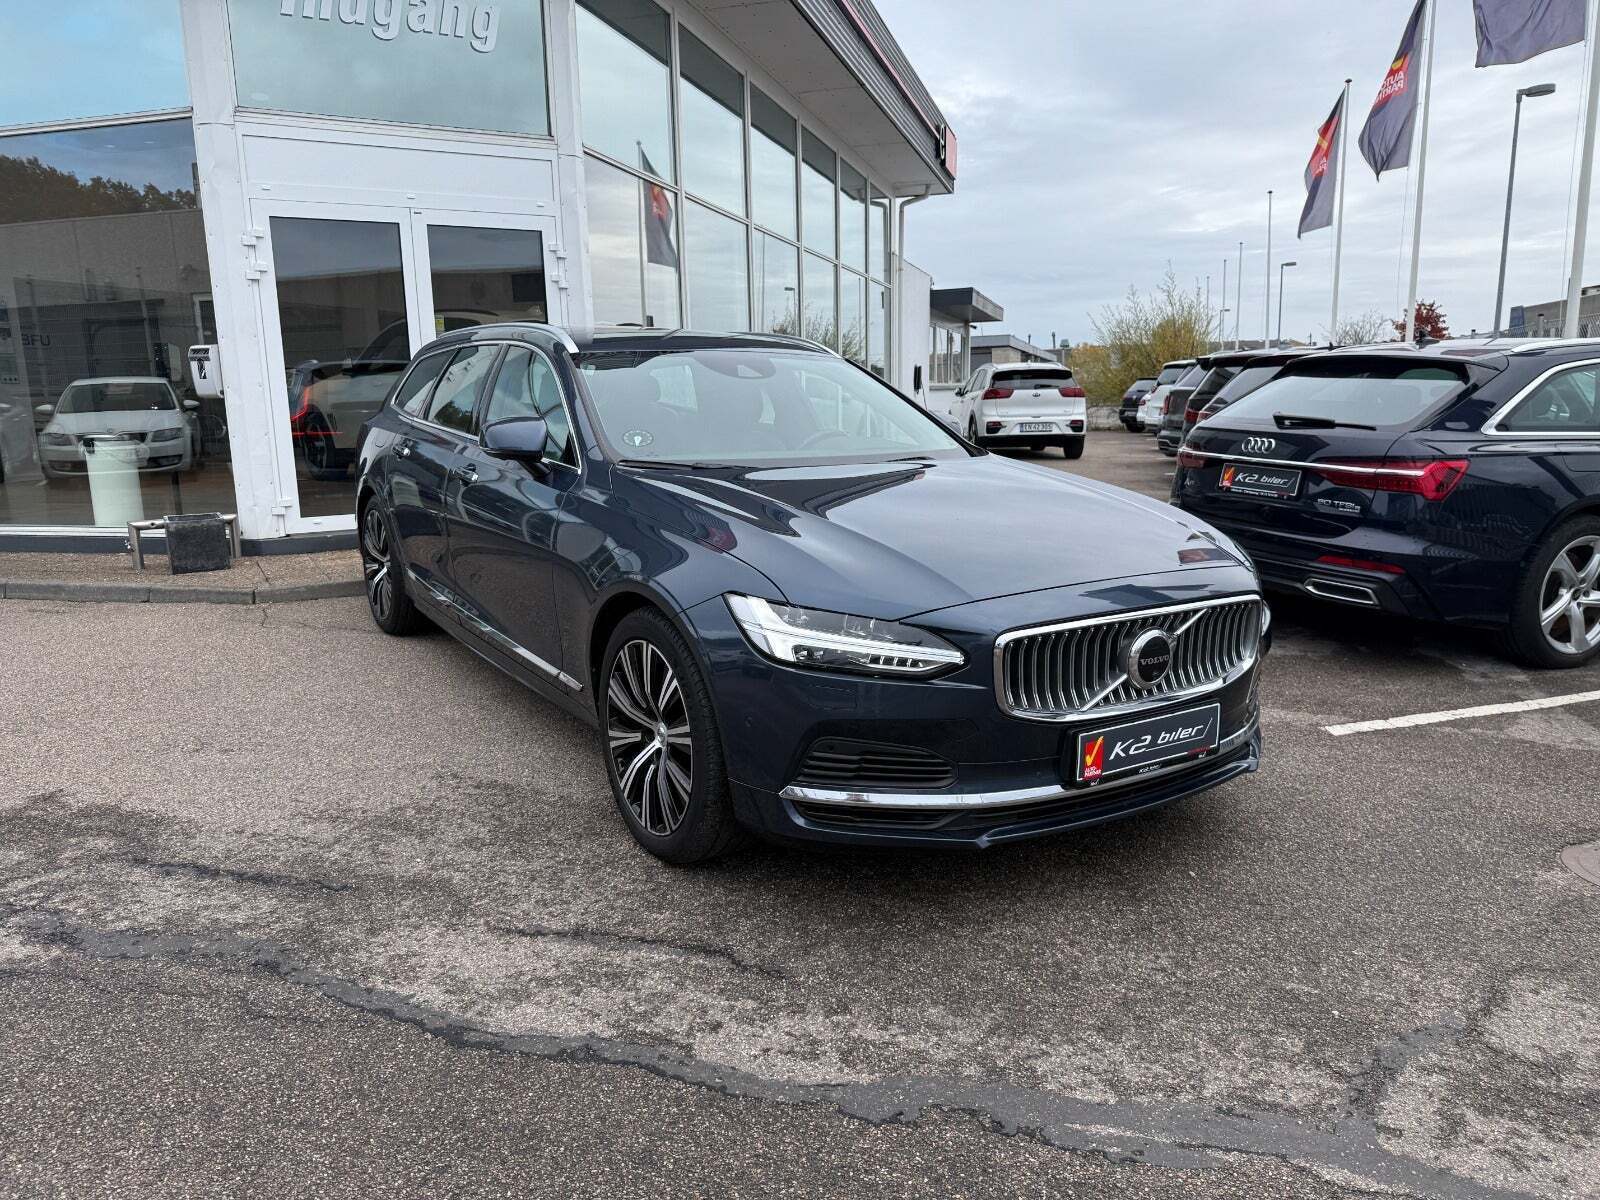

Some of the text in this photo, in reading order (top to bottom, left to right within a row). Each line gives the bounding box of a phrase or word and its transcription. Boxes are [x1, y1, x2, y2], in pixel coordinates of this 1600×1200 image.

[1235, 472, 1288, 485] K2 biler
[1140, 655, 1170, 665] VOLVO
[1109, 725, 1203, 761] K2 biler
